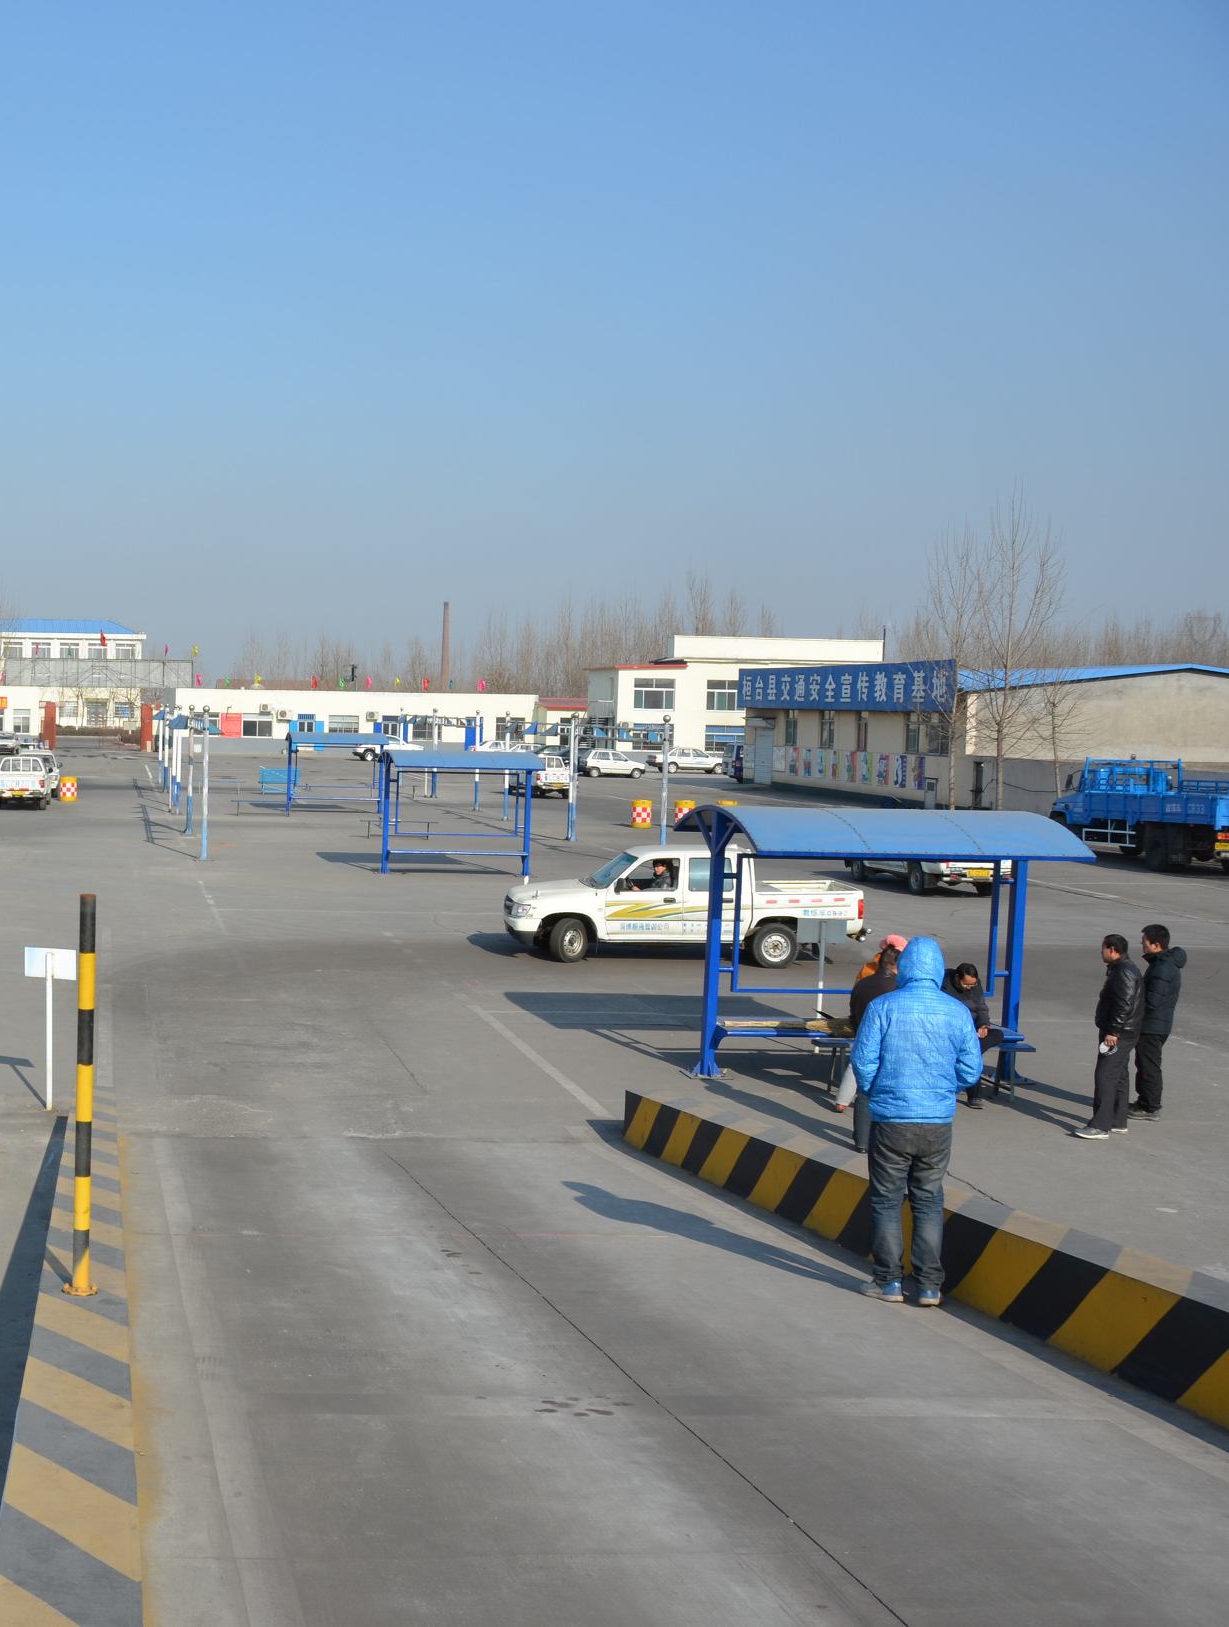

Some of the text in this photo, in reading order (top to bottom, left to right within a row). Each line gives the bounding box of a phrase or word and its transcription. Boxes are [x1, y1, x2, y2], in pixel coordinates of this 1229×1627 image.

[742, 670, 947, 703] 桓台县交通安全宣传教育基地
